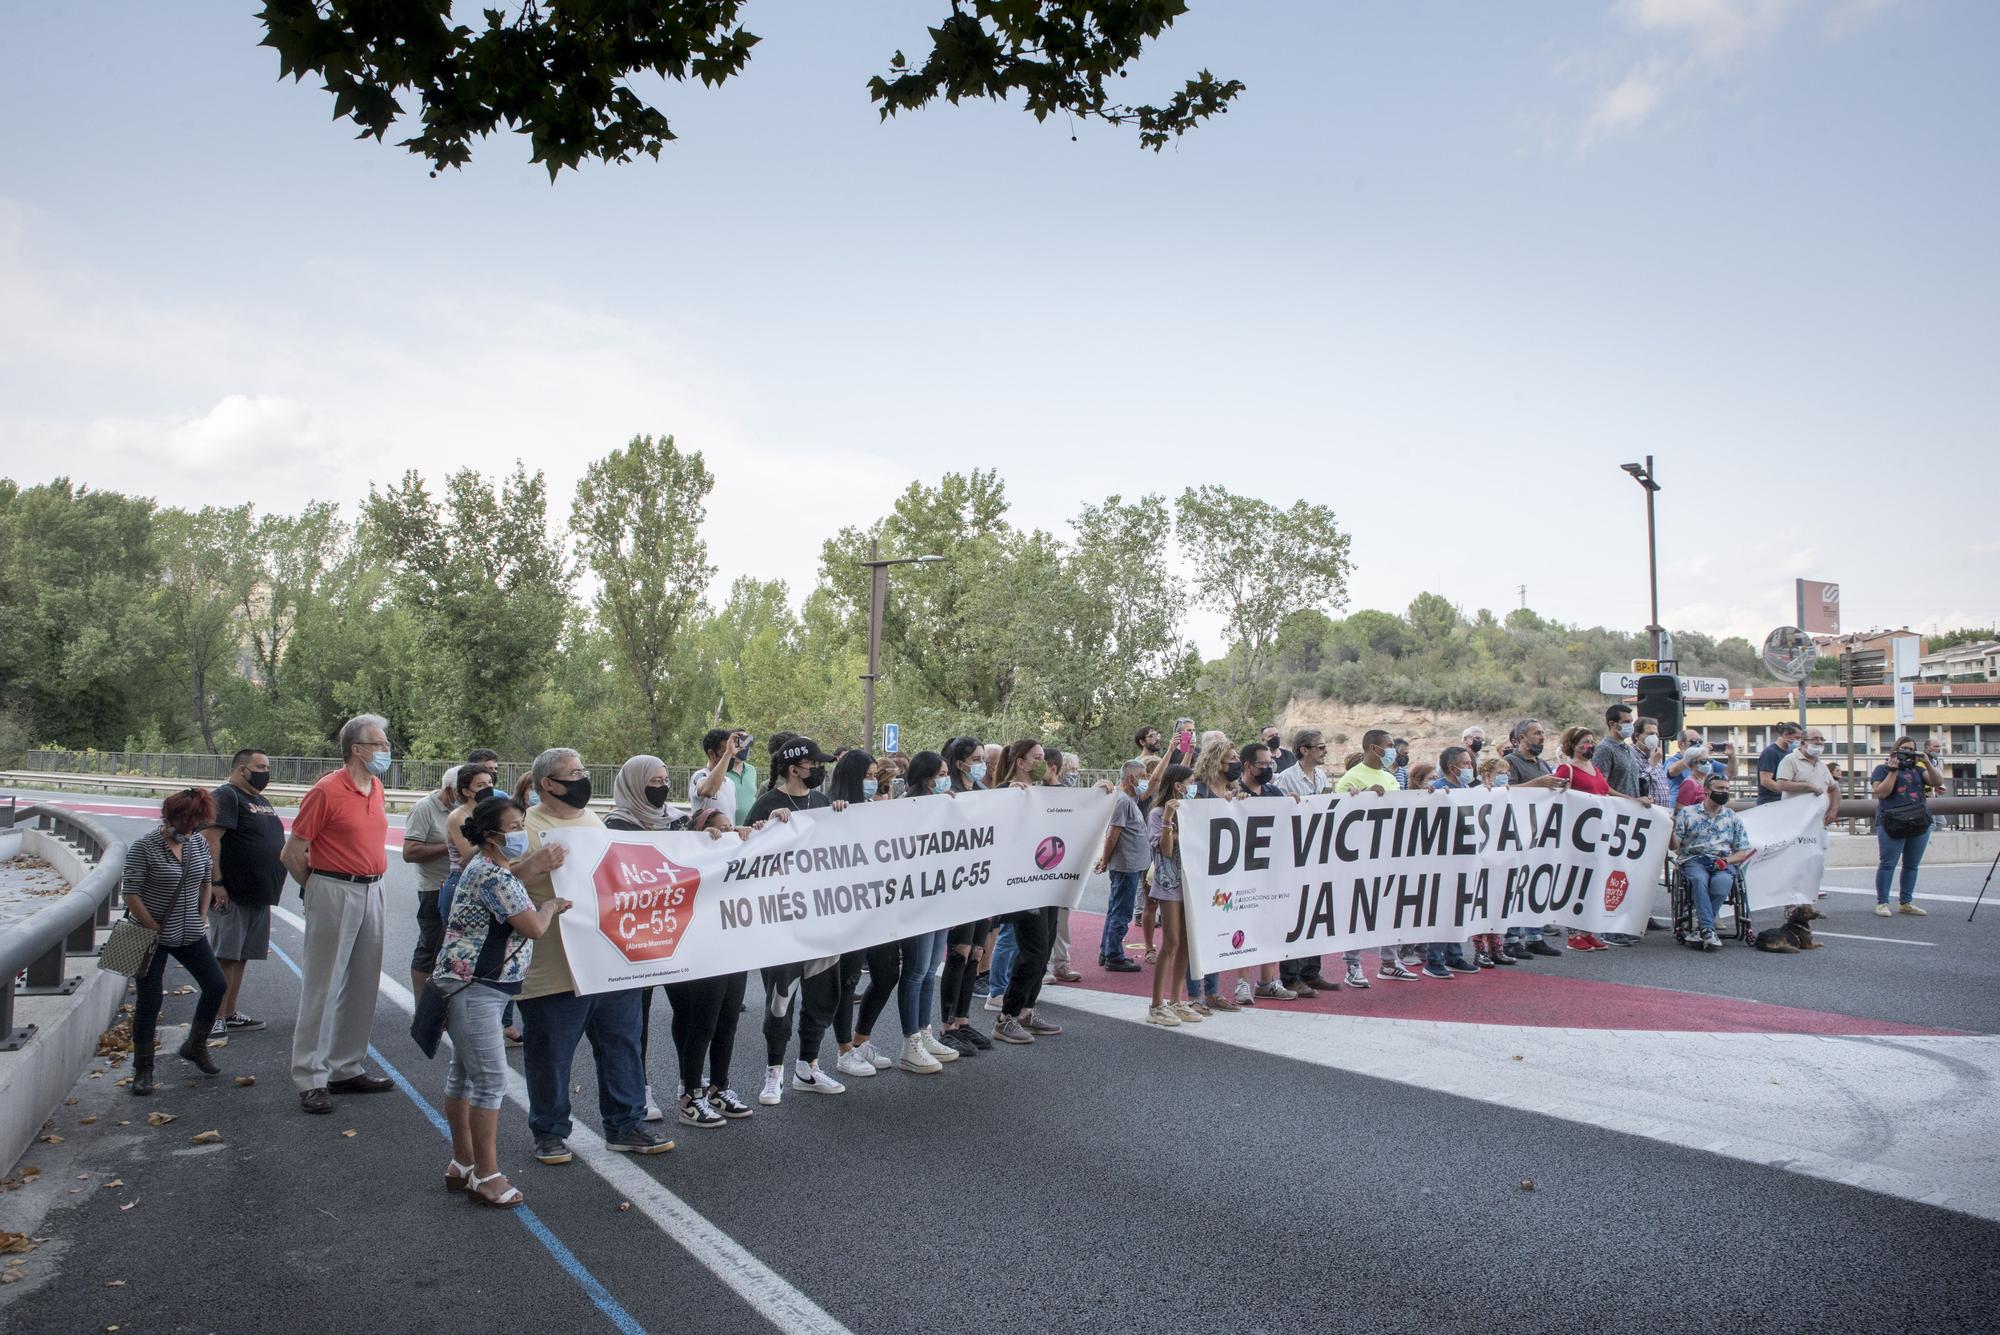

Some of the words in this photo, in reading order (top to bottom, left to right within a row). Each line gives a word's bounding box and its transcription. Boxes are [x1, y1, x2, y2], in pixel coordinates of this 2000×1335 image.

[1693, 680, 1715, 693] Vilar
[783, 745, 809, 759] 100%
[723, 842, 869, 883] PLATAFORMA
[874, 825, 994, 863] CIUTADANA
[1208, 815, 1275, 876] DE
[1291, 799, 1492, 868] VÍCTIMES
[1496, 803, 1523, 851] A
[1529, 803, 1563, 849] LA
[1571, 807, 1652, 860] C-55
[614, 885, 686, 911] morts
[719, 897, 753, 930] NO
[758, 886, 808, 925] MÉS
[812, 878, 897, 917] MORTS
[900, 874, 915, 901] A
[921, 869, 946, 898] LA
[951, 860, 991, 891] C-55
[1285, 881, 1336, 943] JA
[1454, 868, 1489, 927] HA
[1501, 863, 1594, 919] PROU!
[619, 908, 677, 939] C-55
